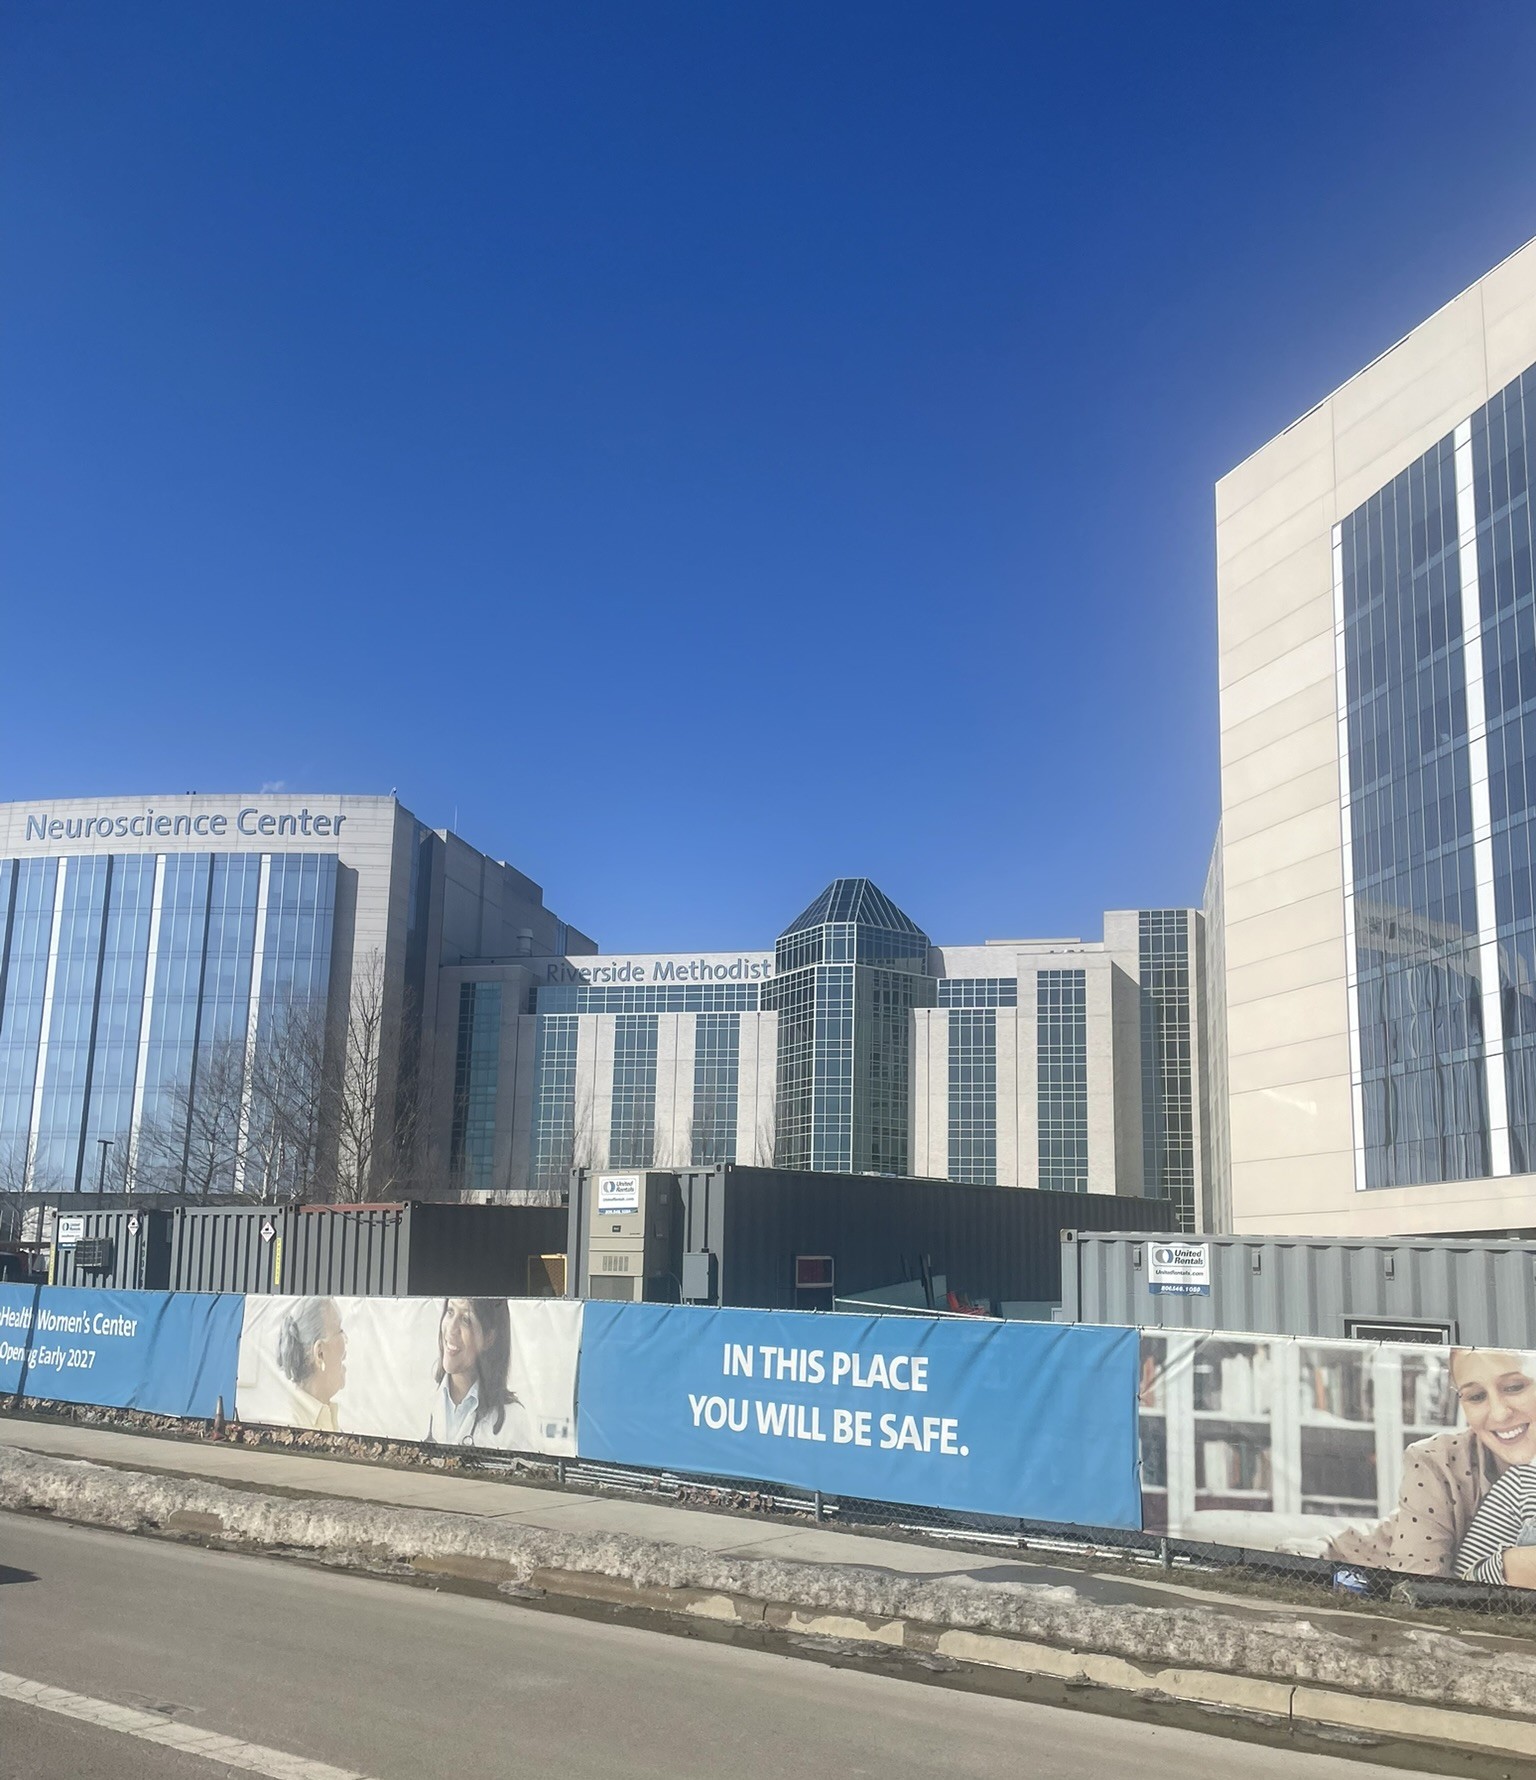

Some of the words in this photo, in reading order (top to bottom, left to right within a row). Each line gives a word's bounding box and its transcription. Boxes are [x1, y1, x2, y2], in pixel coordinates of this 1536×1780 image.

[25, 808, 228, 840] Neuroscience
[236, 808, 347, 836] Center
[546, 961, 645, 983] Riverside
[652, 958, 771, 982] Methodist
[1174, 1249, 1202, 1258] United
[1174, 1257, 1204, 1265] Rentals
[37, 1309, 91, 1334] Women's
[92, 1312, 138, 1337] Center
[38, 1346, 66, 1372] Early
[67, 1348, 96, 1369] 2027
[722, 1343, 754, 1377] IN
[759, 1346, 826, 1384] THIS
[832, 1351, 929, 1392] PLACE
[688, 1394, 749, 1432] YOU
[755, 1401, 827, 1442] WILL
[833, 1409, 872, 1447] BE
[879, 1413, 970, 1457] SAFE.
